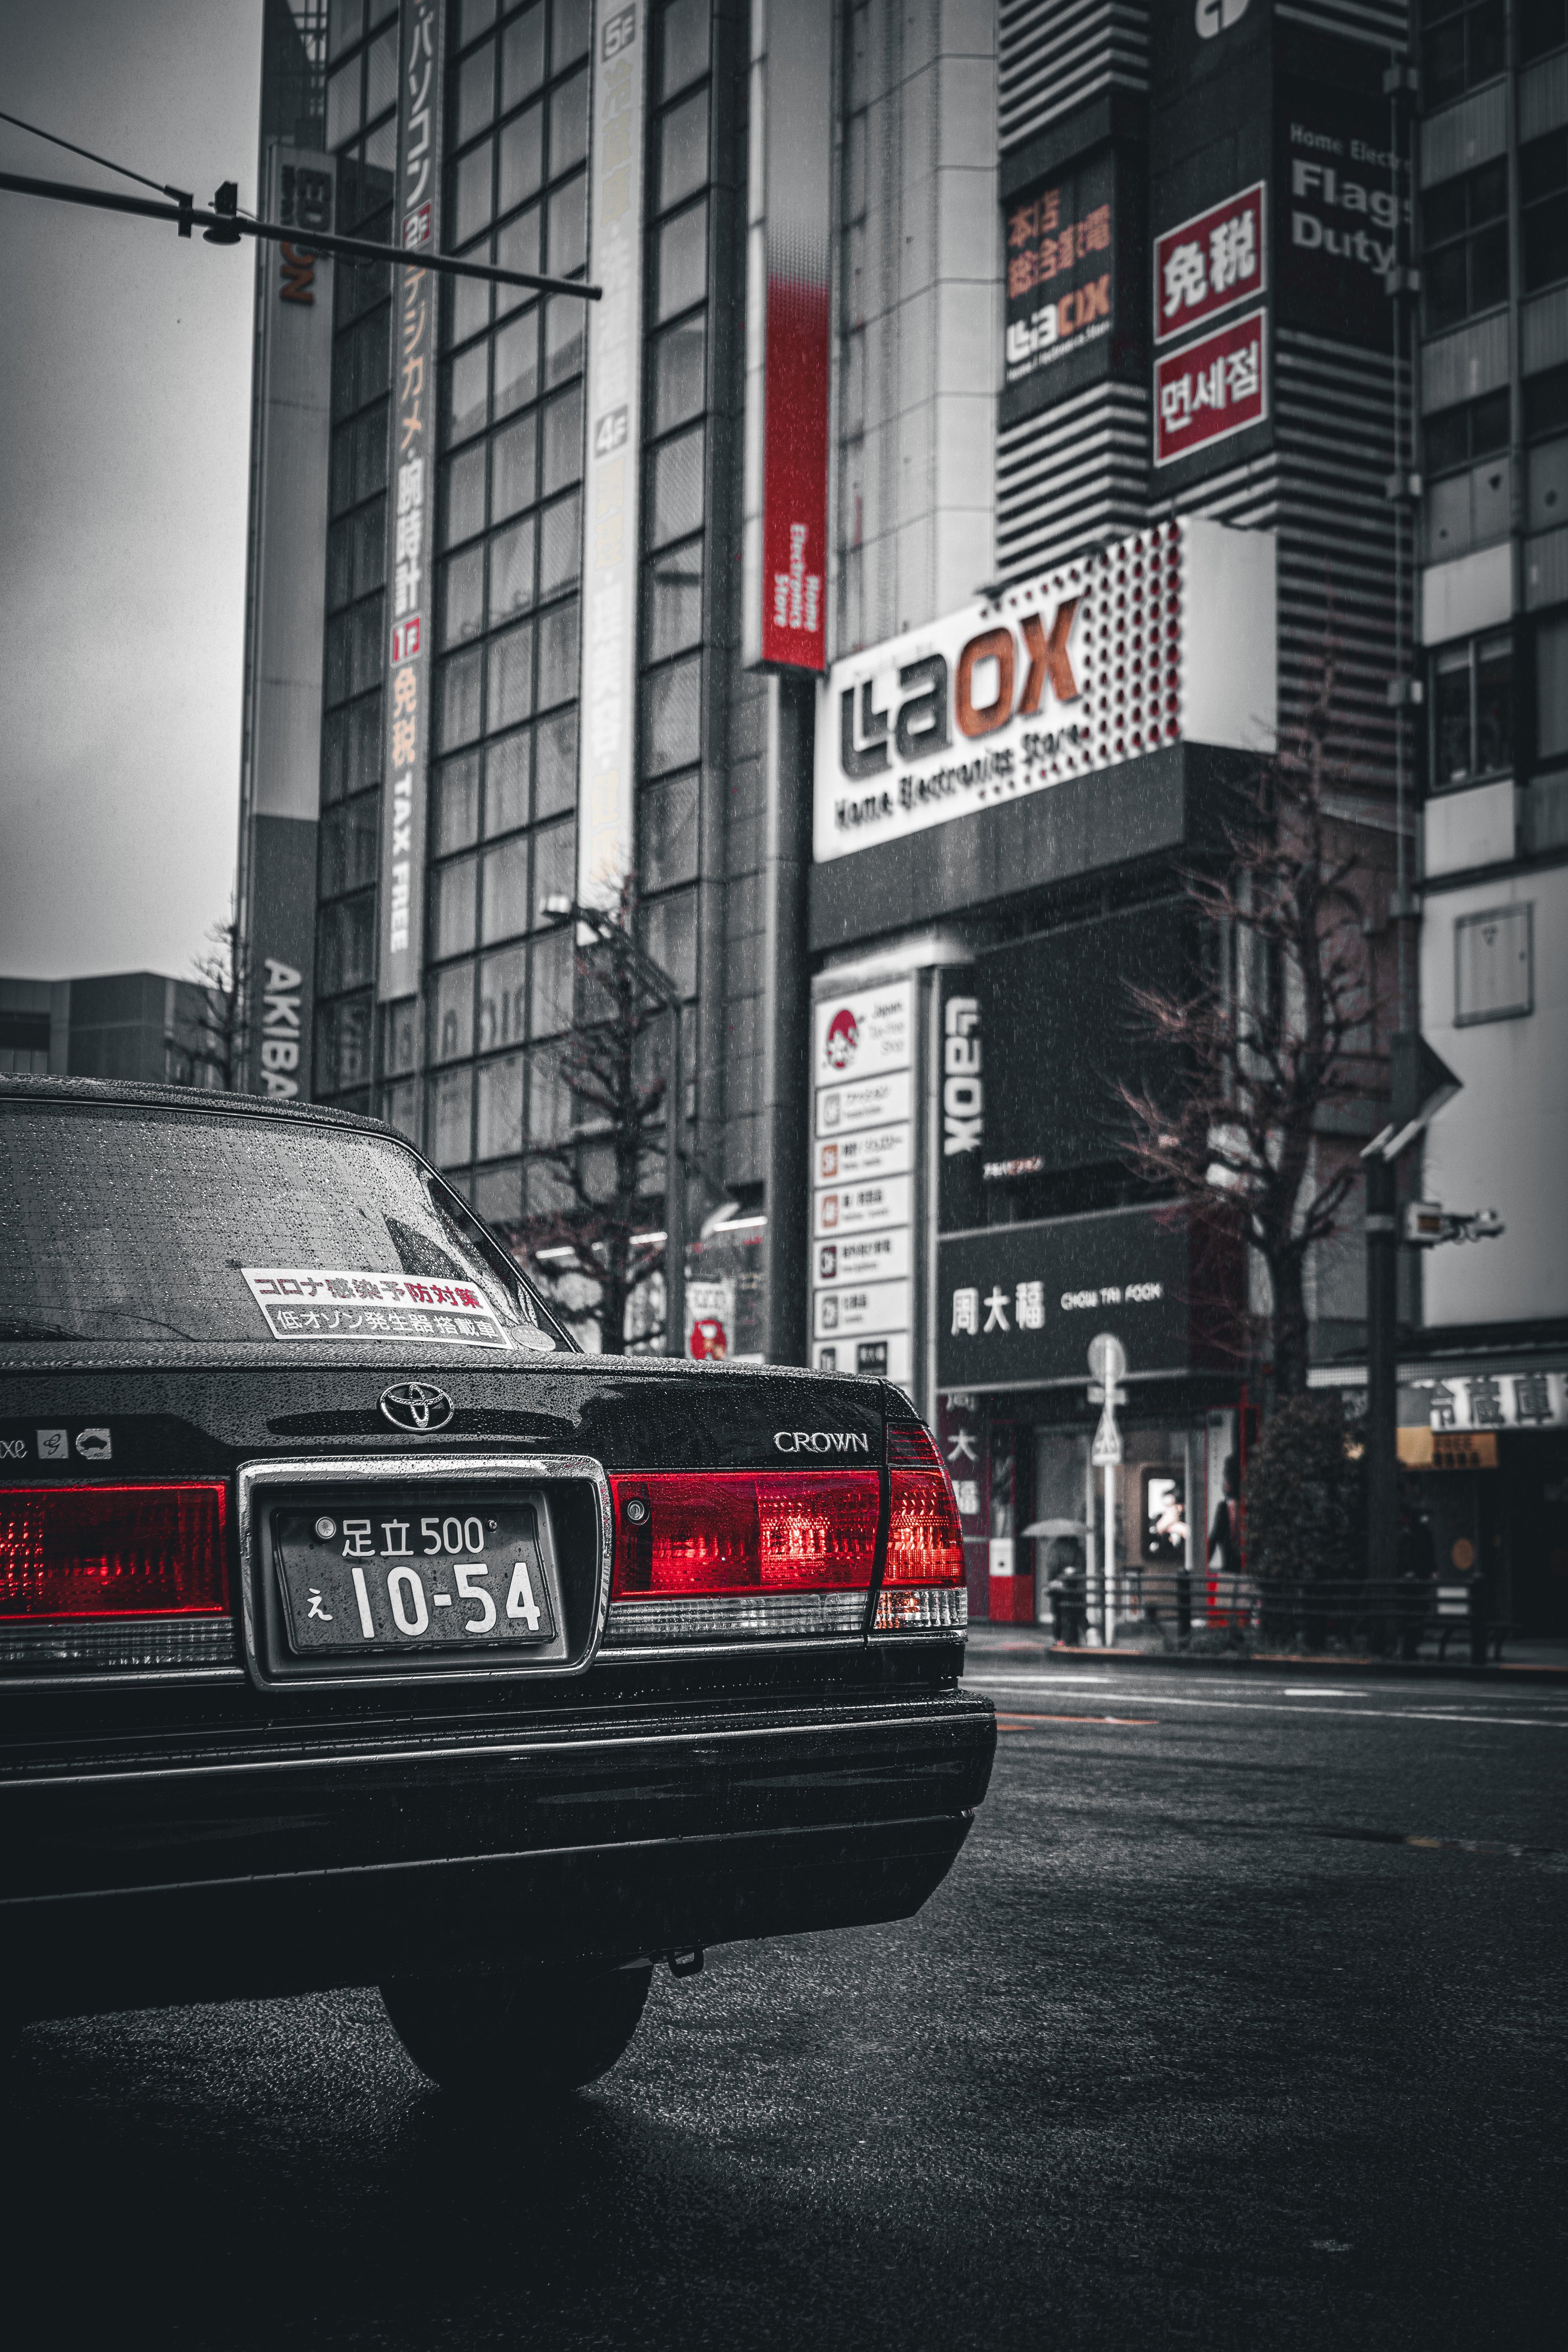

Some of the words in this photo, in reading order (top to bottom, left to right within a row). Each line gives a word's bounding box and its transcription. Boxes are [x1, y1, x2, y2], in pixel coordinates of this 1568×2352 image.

[408, 5, 434, 207] パソコン
[1290, 122, 1345, 156] Home
[1163, 209, 1257, 318] 免税
[1292, 210, 1396, 274] Duty
[1160, 340, 1259, 433] 면세점
[393, 771, 412, 856] TAX
[835, 792, 893, 831] Home
[899, 748, 1014, 811] Electronics
[1021, 724, 1081, 765] Store
[390, 863, 410, 953] FREE
[261, 957, 302, 1098] AKIBA
[254, 1277, 484, 1308] コロナ感染予防対策
[951, 1280, 1045, 1336] 周大福
[0, 1440, 27, 1458] xe
[773, 1432, 869, 1453] CROWN
[307, 1588, 333, 1621] え
[352, 1562, 541, 1638] 10-54
